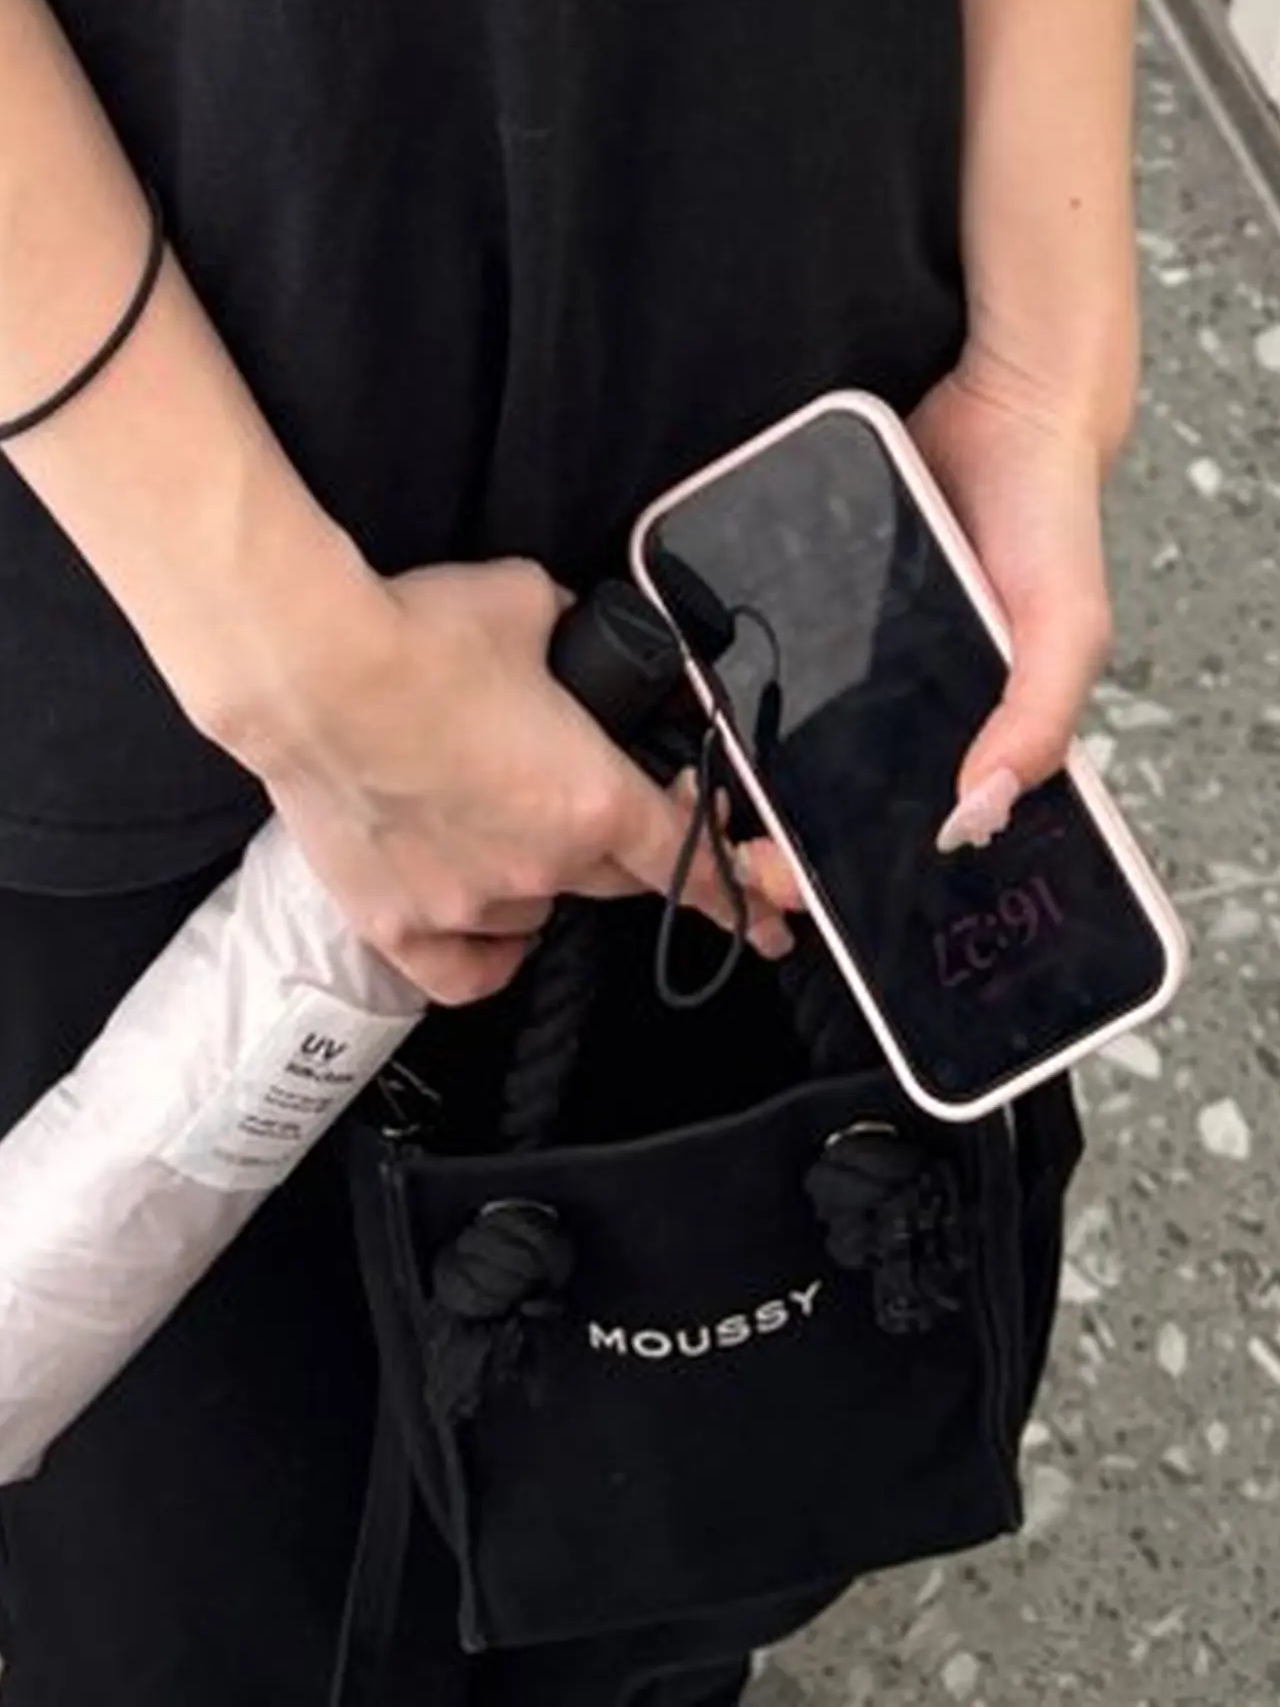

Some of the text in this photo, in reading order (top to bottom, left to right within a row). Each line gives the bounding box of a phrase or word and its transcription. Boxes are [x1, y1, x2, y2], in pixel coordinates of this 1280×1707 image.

[933, 875, 1064, 987] 16:27
[300, 1032, 348, 1062] UV
[587, 1279, 821, 1357] MOUSSY
